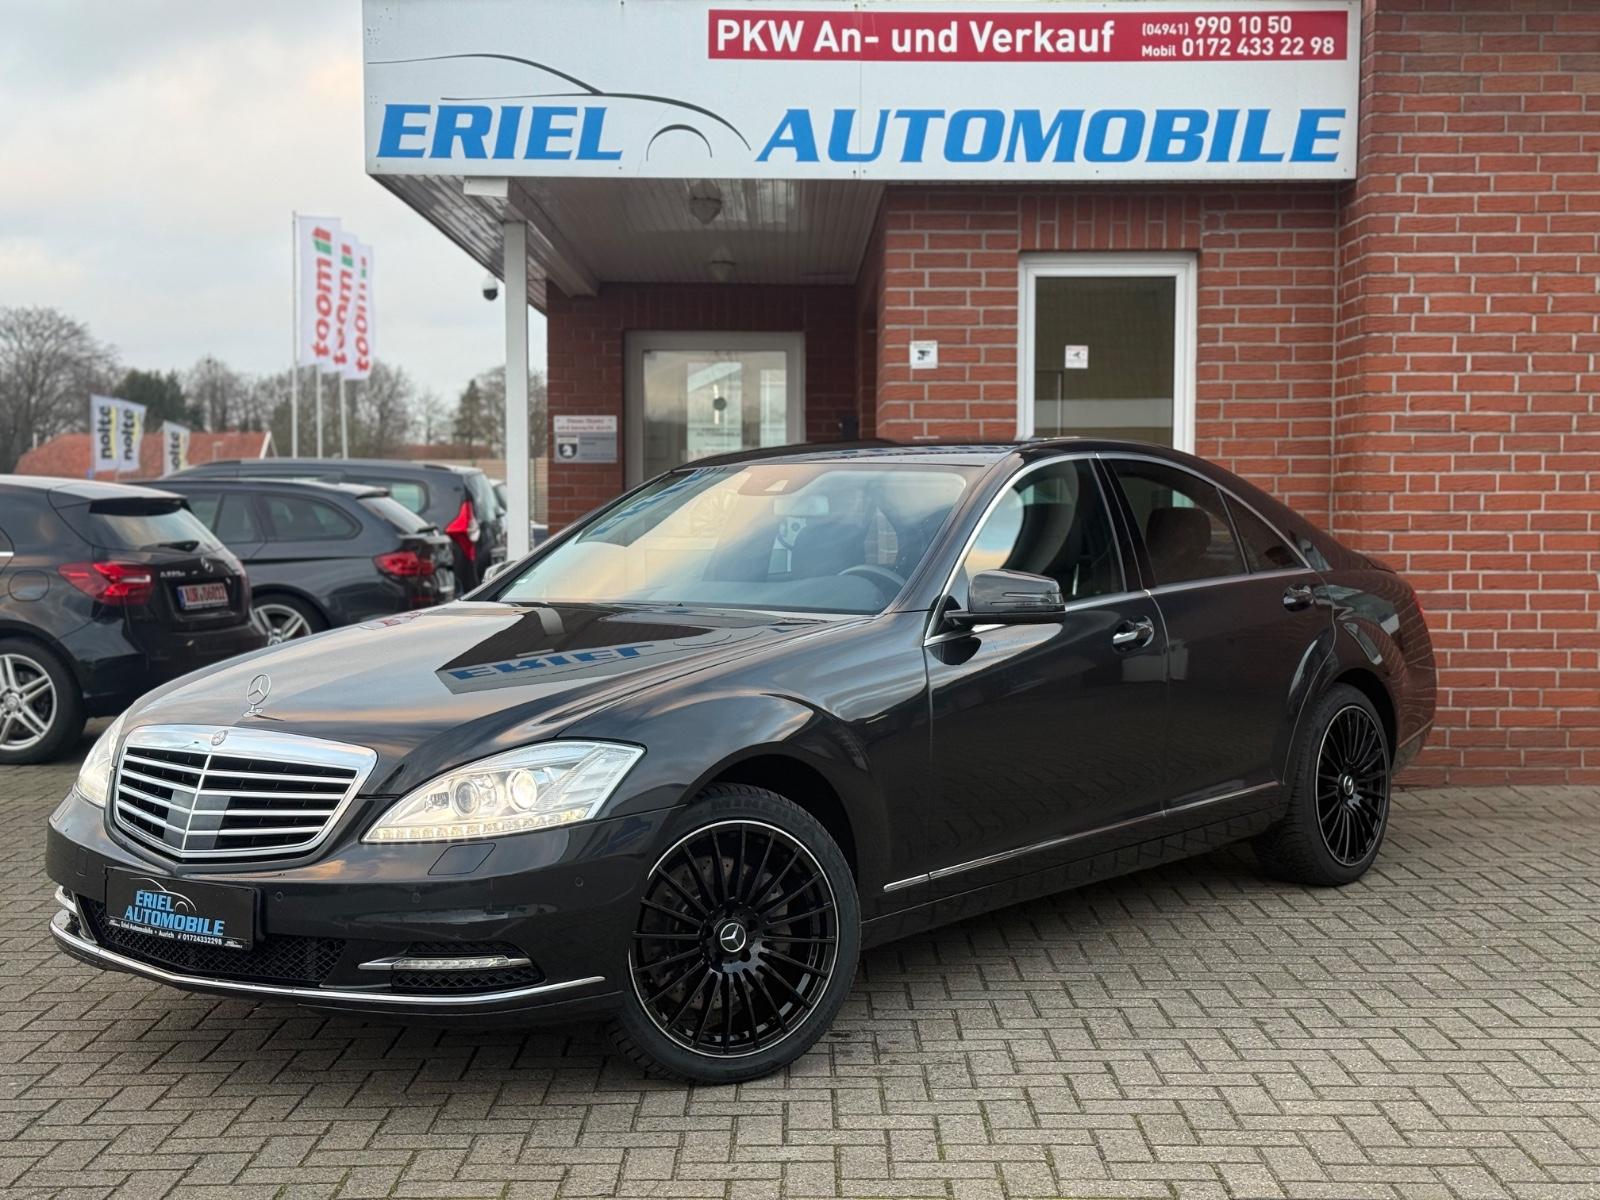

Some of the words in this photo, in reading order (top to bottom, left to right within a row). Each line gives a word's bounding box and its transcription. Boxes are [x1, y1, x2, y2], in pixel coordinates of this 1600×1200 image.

[717, 19, 804, 52] PKW
[813, 20, 879, 53] An-
[891, 21, 958, 53] und
[969, 20, 1115, 53] Verkauf
[1142, 22, 1189, 36] (04941)
[1195, 16, 1231, 35] 990
[1239, 16, 1262, 34] 10
[1268, 16, 1292, 34] 50
[1141, 45, 1176, 57] Mobil
[1182, 38, 1231, 56] 0172
[1237, 38, 1273, 56] 433
[1280, 37, 1304, 56] 22
[1311, 37, 1335, 55] 98
[376, 103, 624, 161] ERIEL
[755, 108, 1346, 164] AUTOMOBILE
[312, 256, 332, 358] toom
[97, 405, 113, 460] nolte
[135, 889, 175, 912] ERIEL
[124, 905, 225, 936] AUTOMOBILE
[158, 928, 175, 939] Aurich
